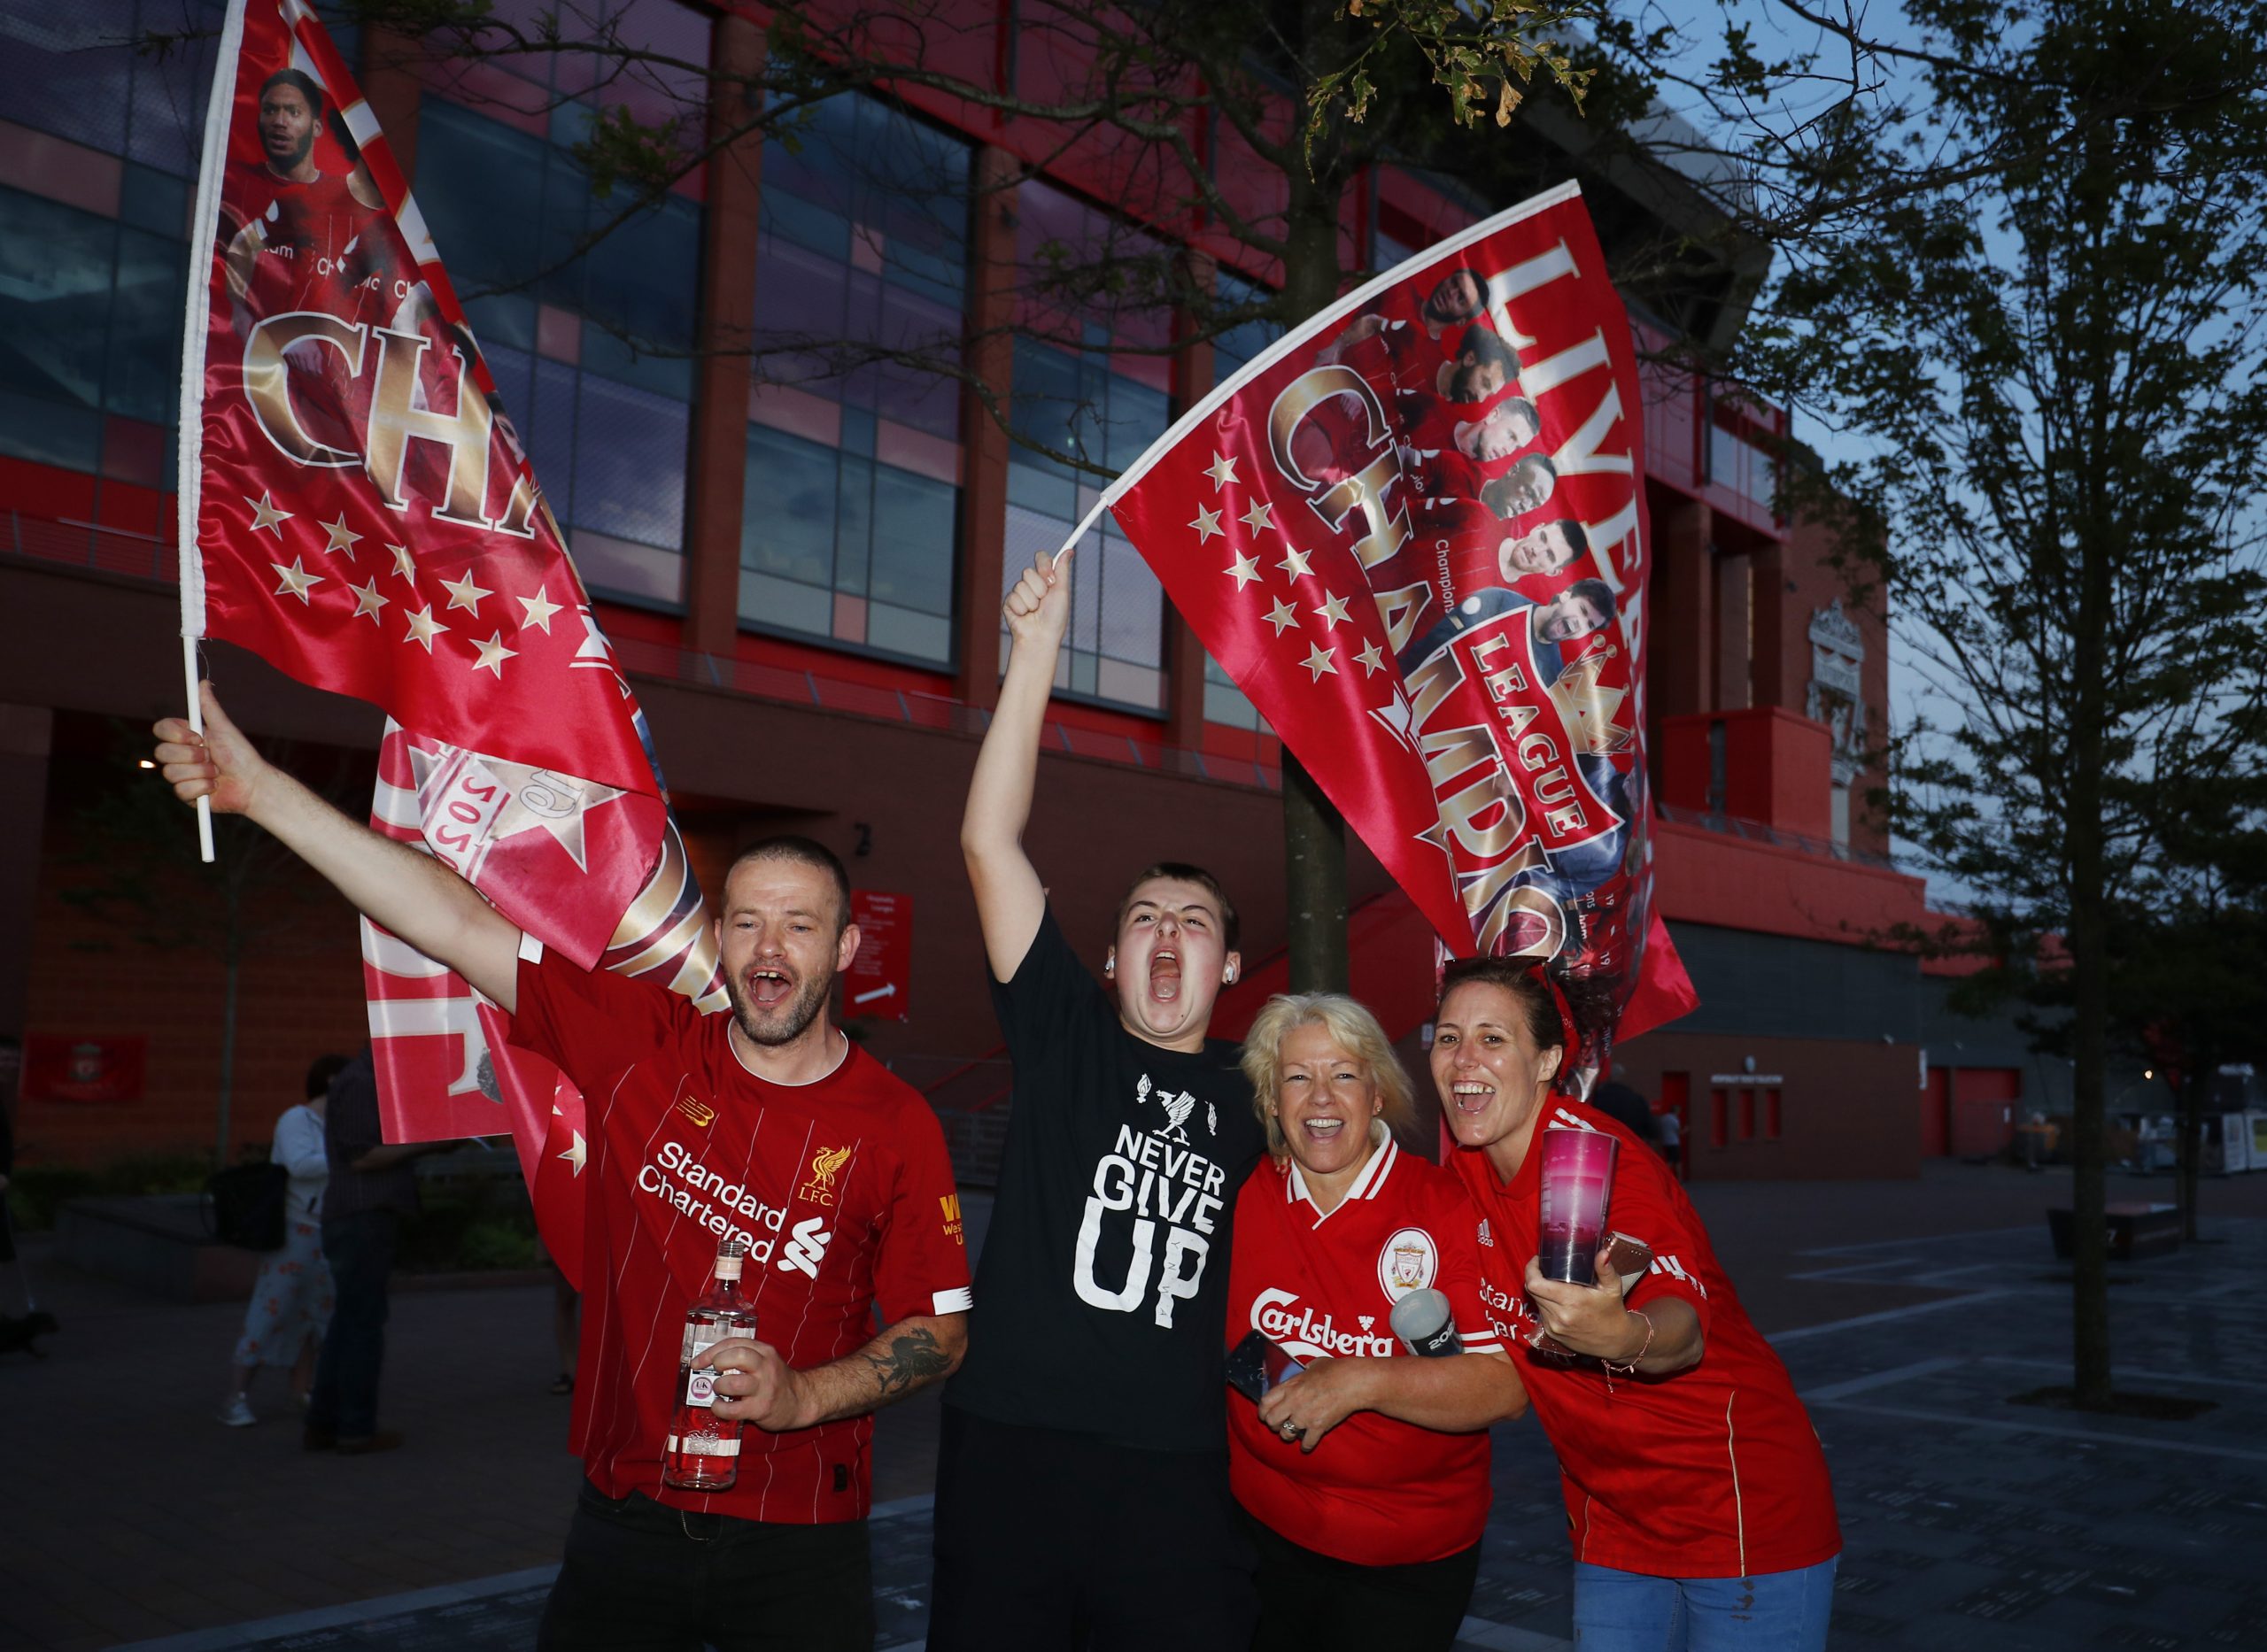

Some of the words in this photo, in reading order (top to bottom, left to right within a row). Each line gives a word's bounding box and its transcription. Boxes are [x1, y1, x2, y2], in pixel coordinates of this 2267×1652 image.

[1435, 538, 1456, 614] Champions
[1470, 631, 1589, 838] LEAGUE
[656, 1141, 788, 1233] Standard
[1093, 1154, 1226, 1236] GIVE
[1114, 1123, 1226, 1197] NEVER
[638, 1163, 776, 1265] Chartered
[1072, 1195, 1211, 1330] UP
